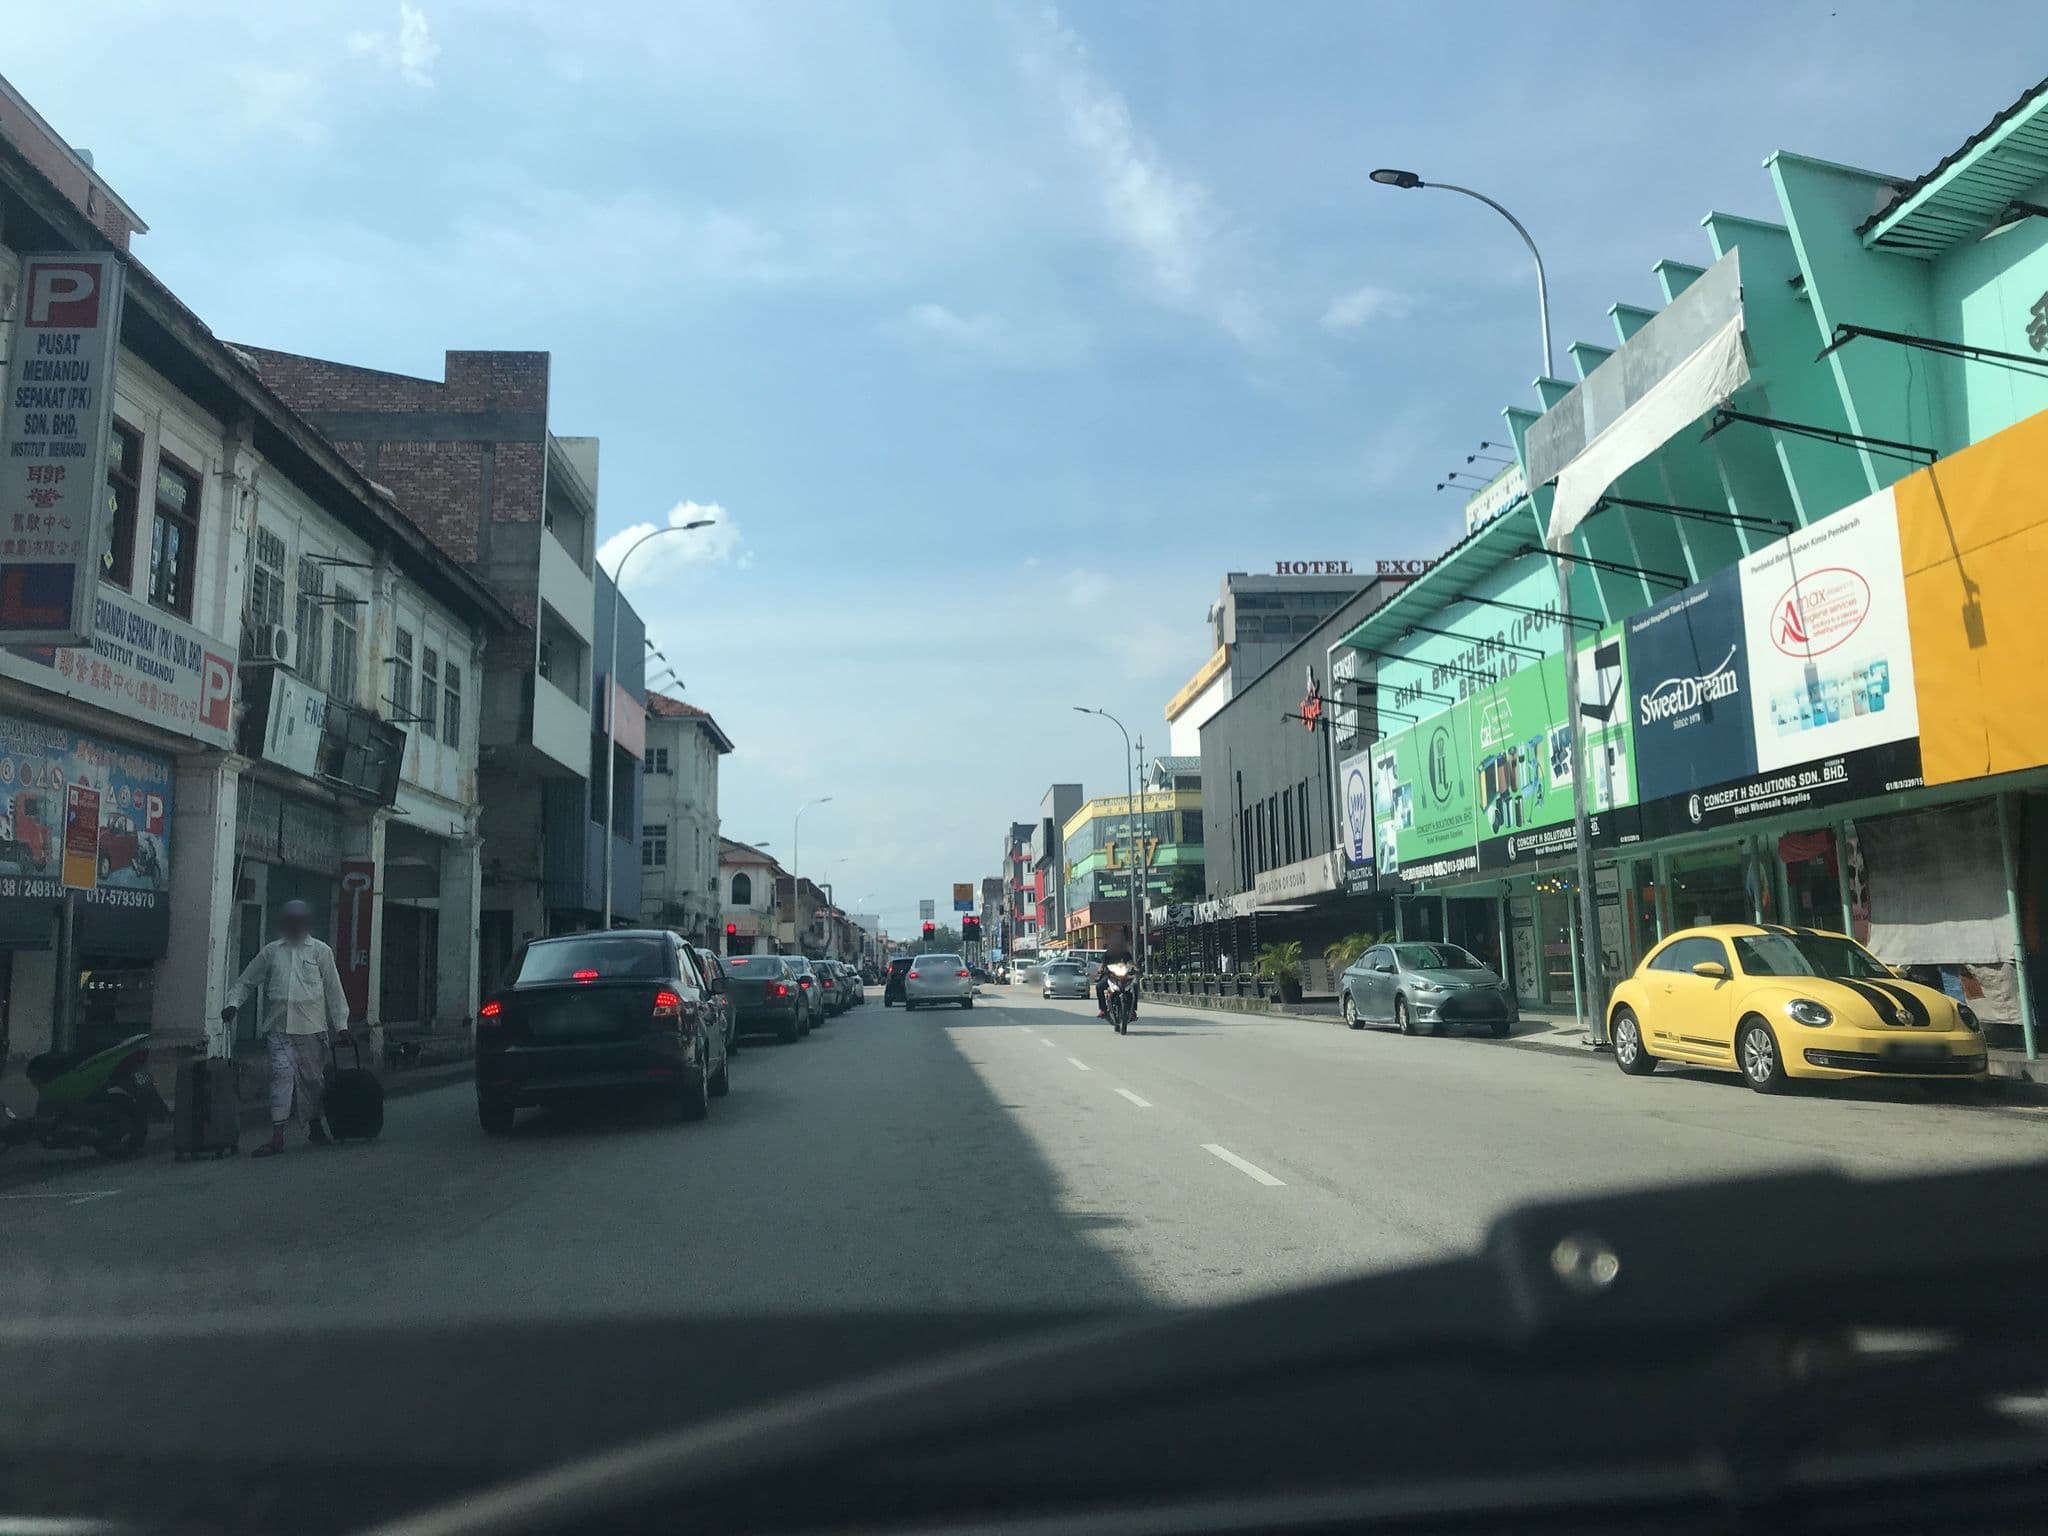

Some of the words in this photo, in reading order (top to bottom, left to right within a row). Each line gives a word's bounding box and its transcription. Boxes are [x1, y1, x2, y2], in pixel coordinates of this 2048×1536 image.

[31, 269, 94, 322] P
[37, 334, 81, 356] PUSAT
[22, 360, 90, 382] MEMANDU
[14, 387, 67, 409] SEPAKAT
[68, 387, 92, 410] (PK)
[23, 413, 50, 436] SDN.
[1810, 534, 1828, 547] Kimia
[1827, 517, 1861, 539] Pembersih
[1275, 560, 1353, 575] HOTEL
[95, 598, 127, 640] EMANDU
[94, 635, 134, 668] INSTITUT
[135, 653, 175, 684] MEMANDU
[1431, 629, 1507, 691] BROTHERS
[1510, 599, 1564, 647] (IPOH
[202, 658, 231, 719] P
[1640, 668, 1739, 726] SweetDream
[1673, 715, 1689, 731] since
[1703, 788, 1740, 808] CONCEPT
[1740, 787, 1748, 799] H
[1749, 776, 1797, 798] SOLUTIONS
[1798, 771, 1822, 789] SDN.
[1823, 765, 1848, 783] BHD.
[145, 794, 164, 829] P
[1734, 803, 1750, 816] Hotel
[1750, 798, 1782, 813] Wholesale
[1782, 792, 1811, 807] Supplies
[1516, 834, 1539, 848] CONCEPT
[1543, 827, 1572, 842] SOLUTIONS
